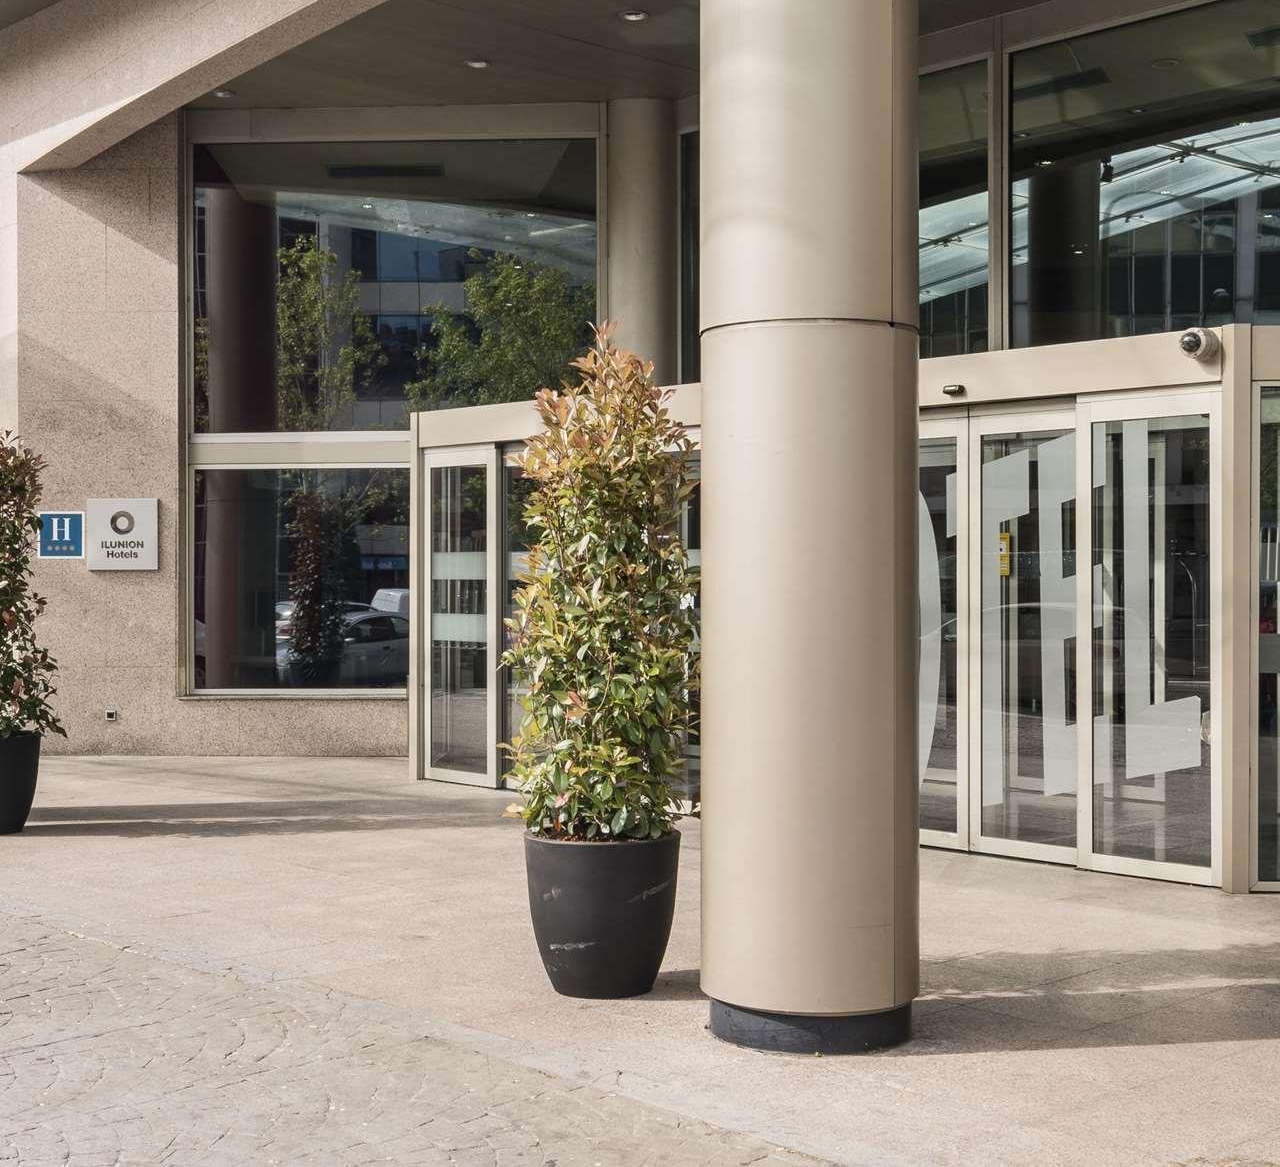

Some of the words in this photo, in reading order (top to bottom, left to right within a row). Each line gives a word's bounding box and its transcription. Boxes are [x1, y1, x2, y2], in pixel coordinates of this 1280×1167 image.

[51, 517, 71, 541] H
[101, 540, 144, 549] ILUNION
[107, 550, 138, 559] Hotels
